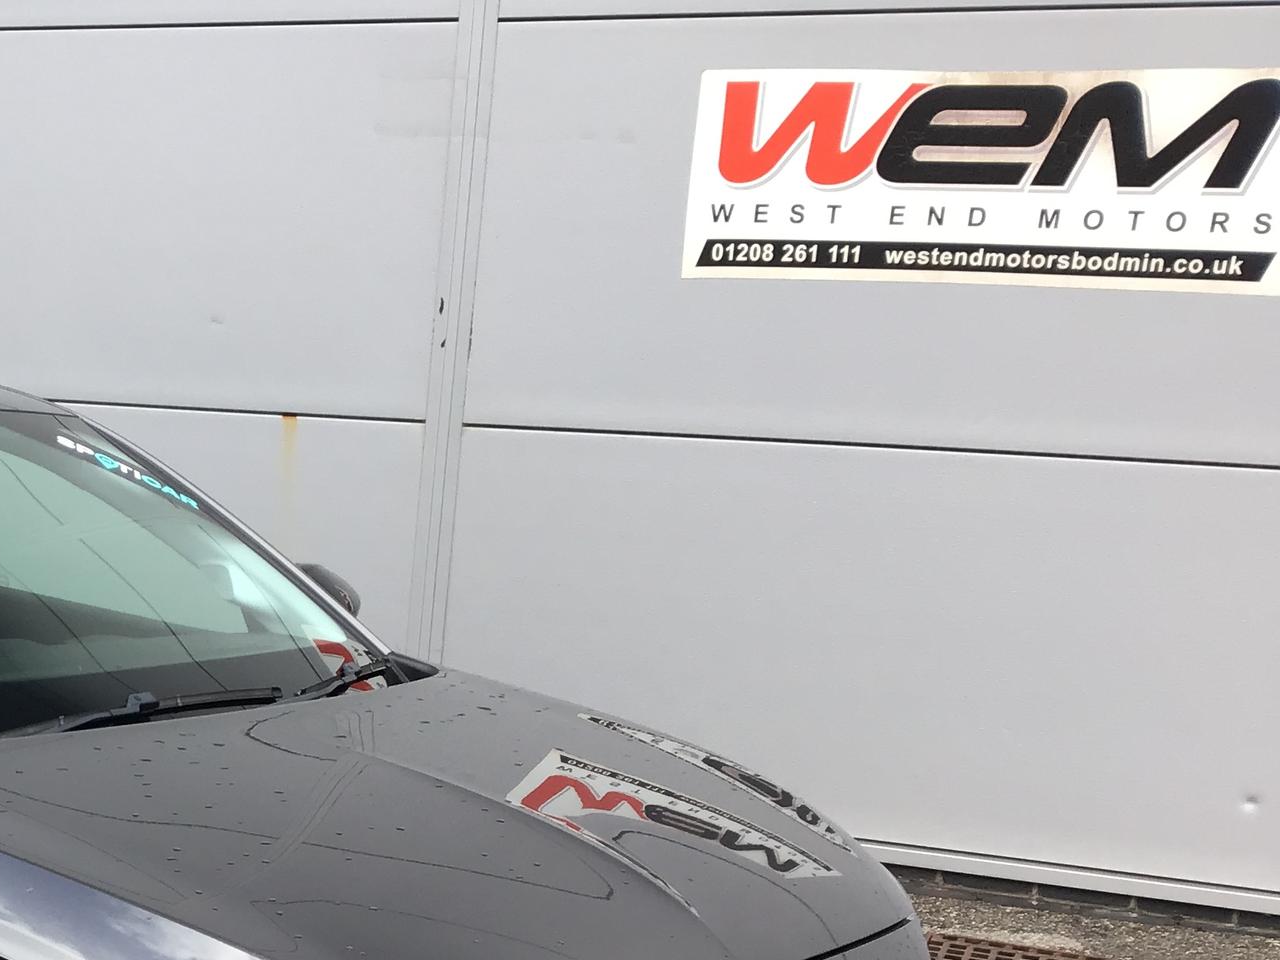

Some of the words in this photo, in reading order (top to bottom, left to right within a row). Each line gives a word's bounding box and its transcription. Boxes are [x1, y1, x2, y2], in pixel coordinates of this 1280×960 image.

[710, 203, 843, 225] WEST
[888, 205, 987, 227] END
[1037, 208, 1273, 235] MOTORS
[710, 242, 775, 262] 01208
[780, 243, 819, 263] 261
[827, 244, 862, 264] 111
[884, 247, 1244, 276] westendmotorsbodmin.co.uk
